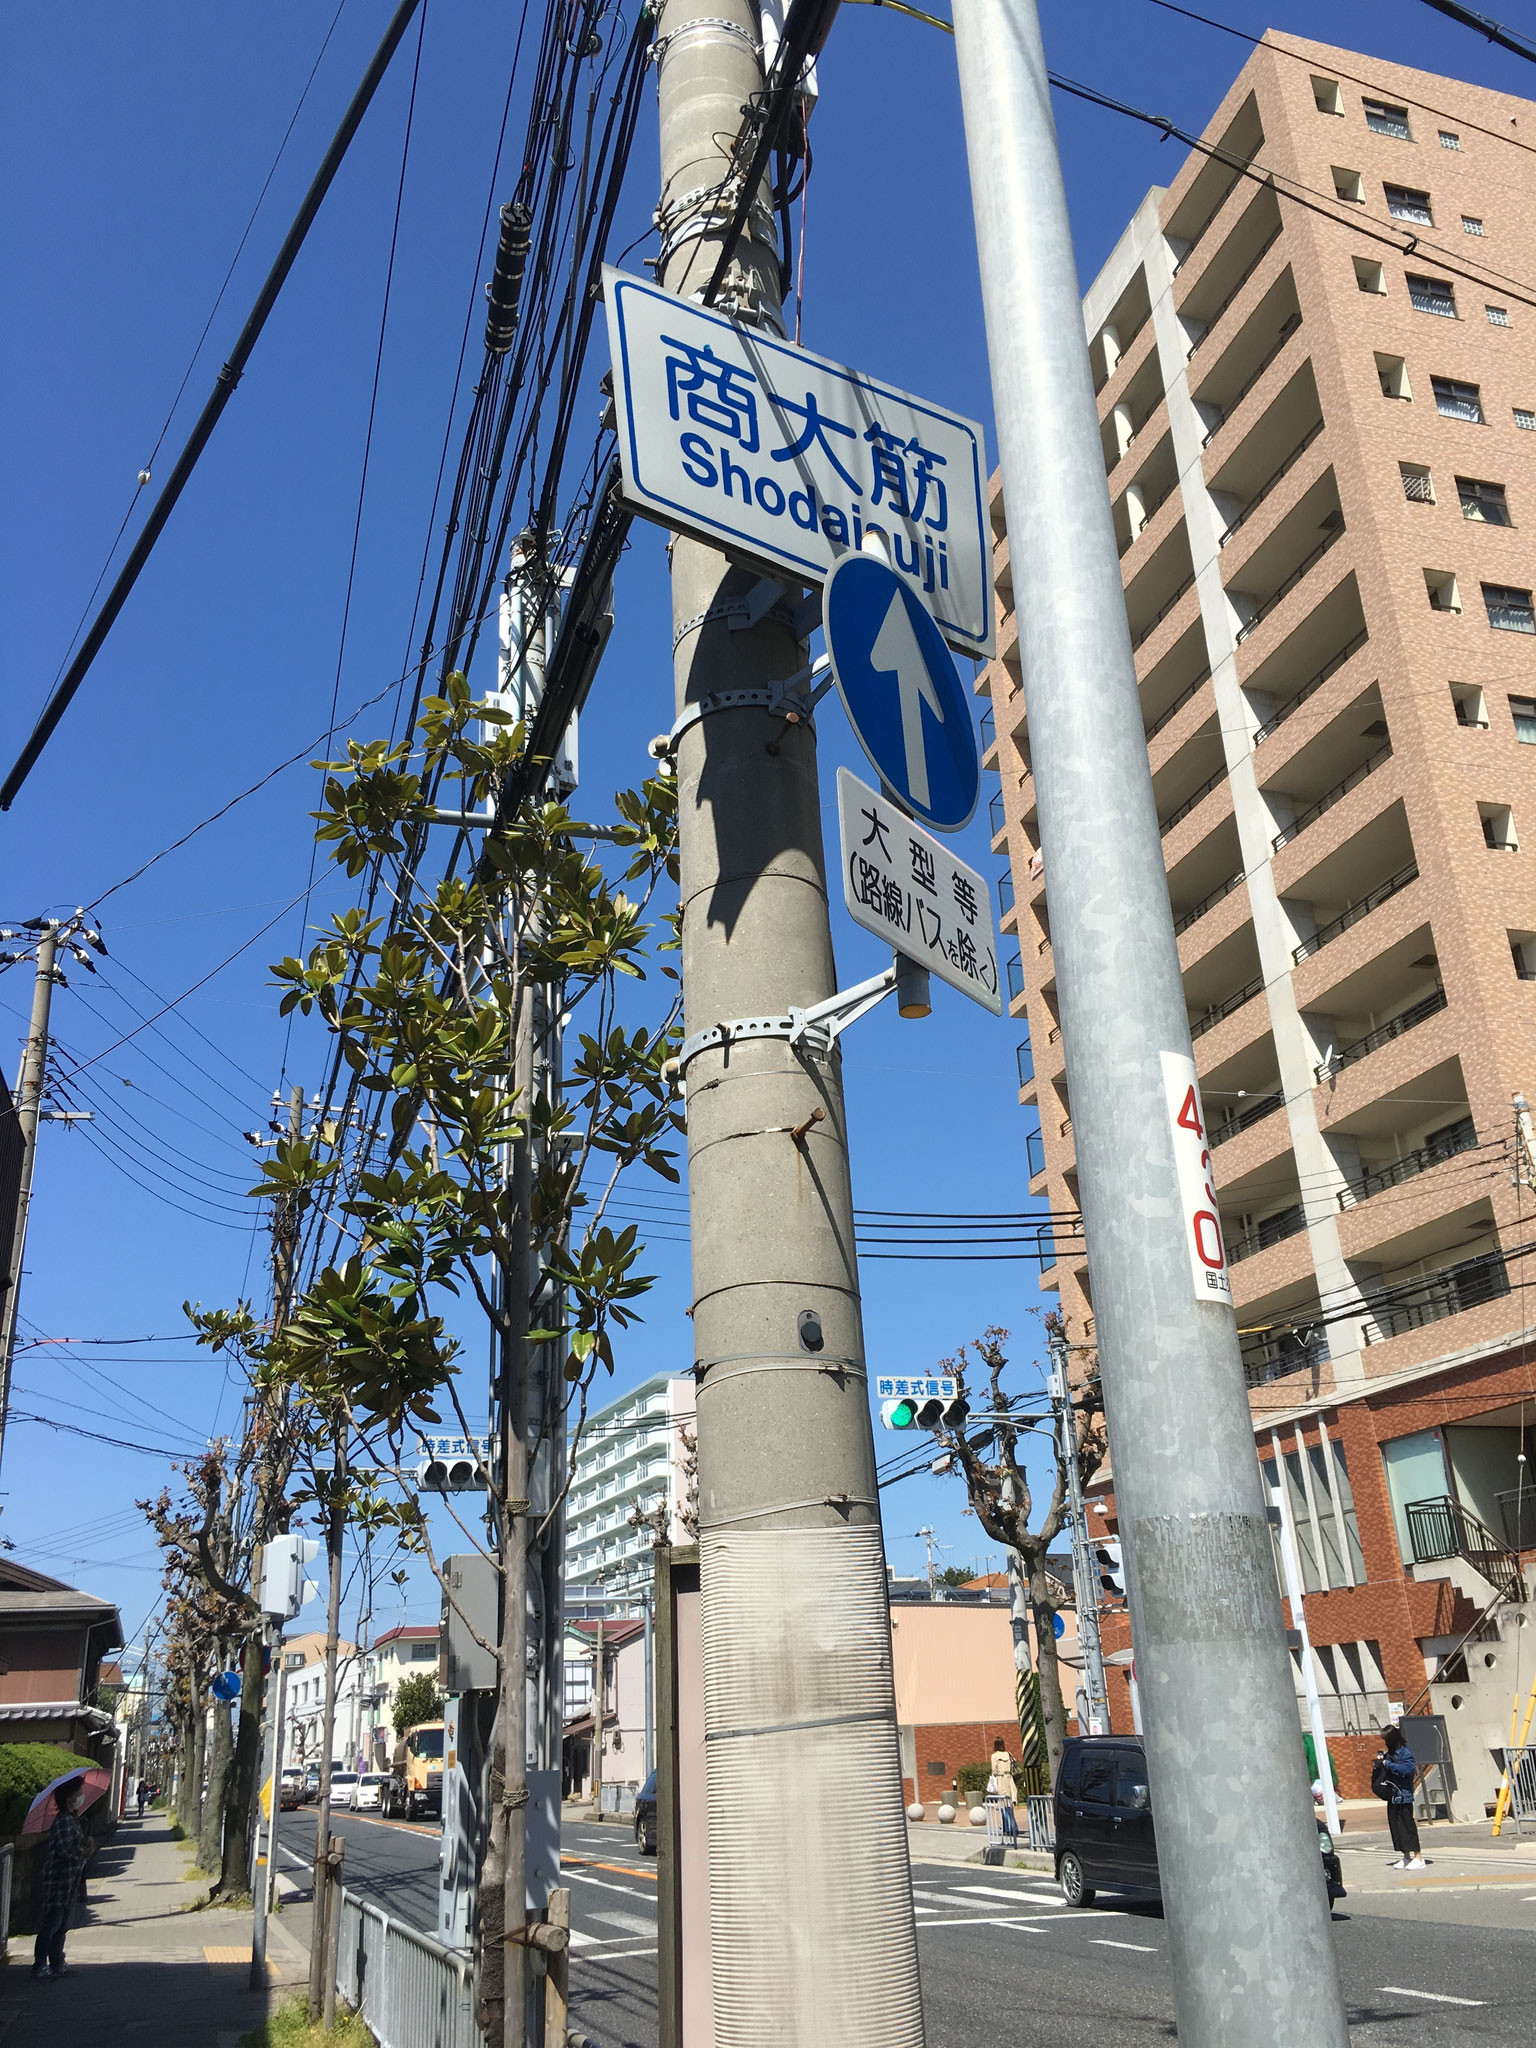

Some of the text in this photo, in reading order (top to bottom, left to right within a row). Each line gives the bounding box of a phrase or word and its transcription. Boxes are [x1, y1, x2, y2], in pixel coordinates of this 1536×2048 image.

[660, 334, 949, 532] 商大筋
[680, 432, 949, 594] Shodaiuji
[1206, 1271, 1230, 1292] 国土
[880, 1379, 954, 1396] 時差式信号
